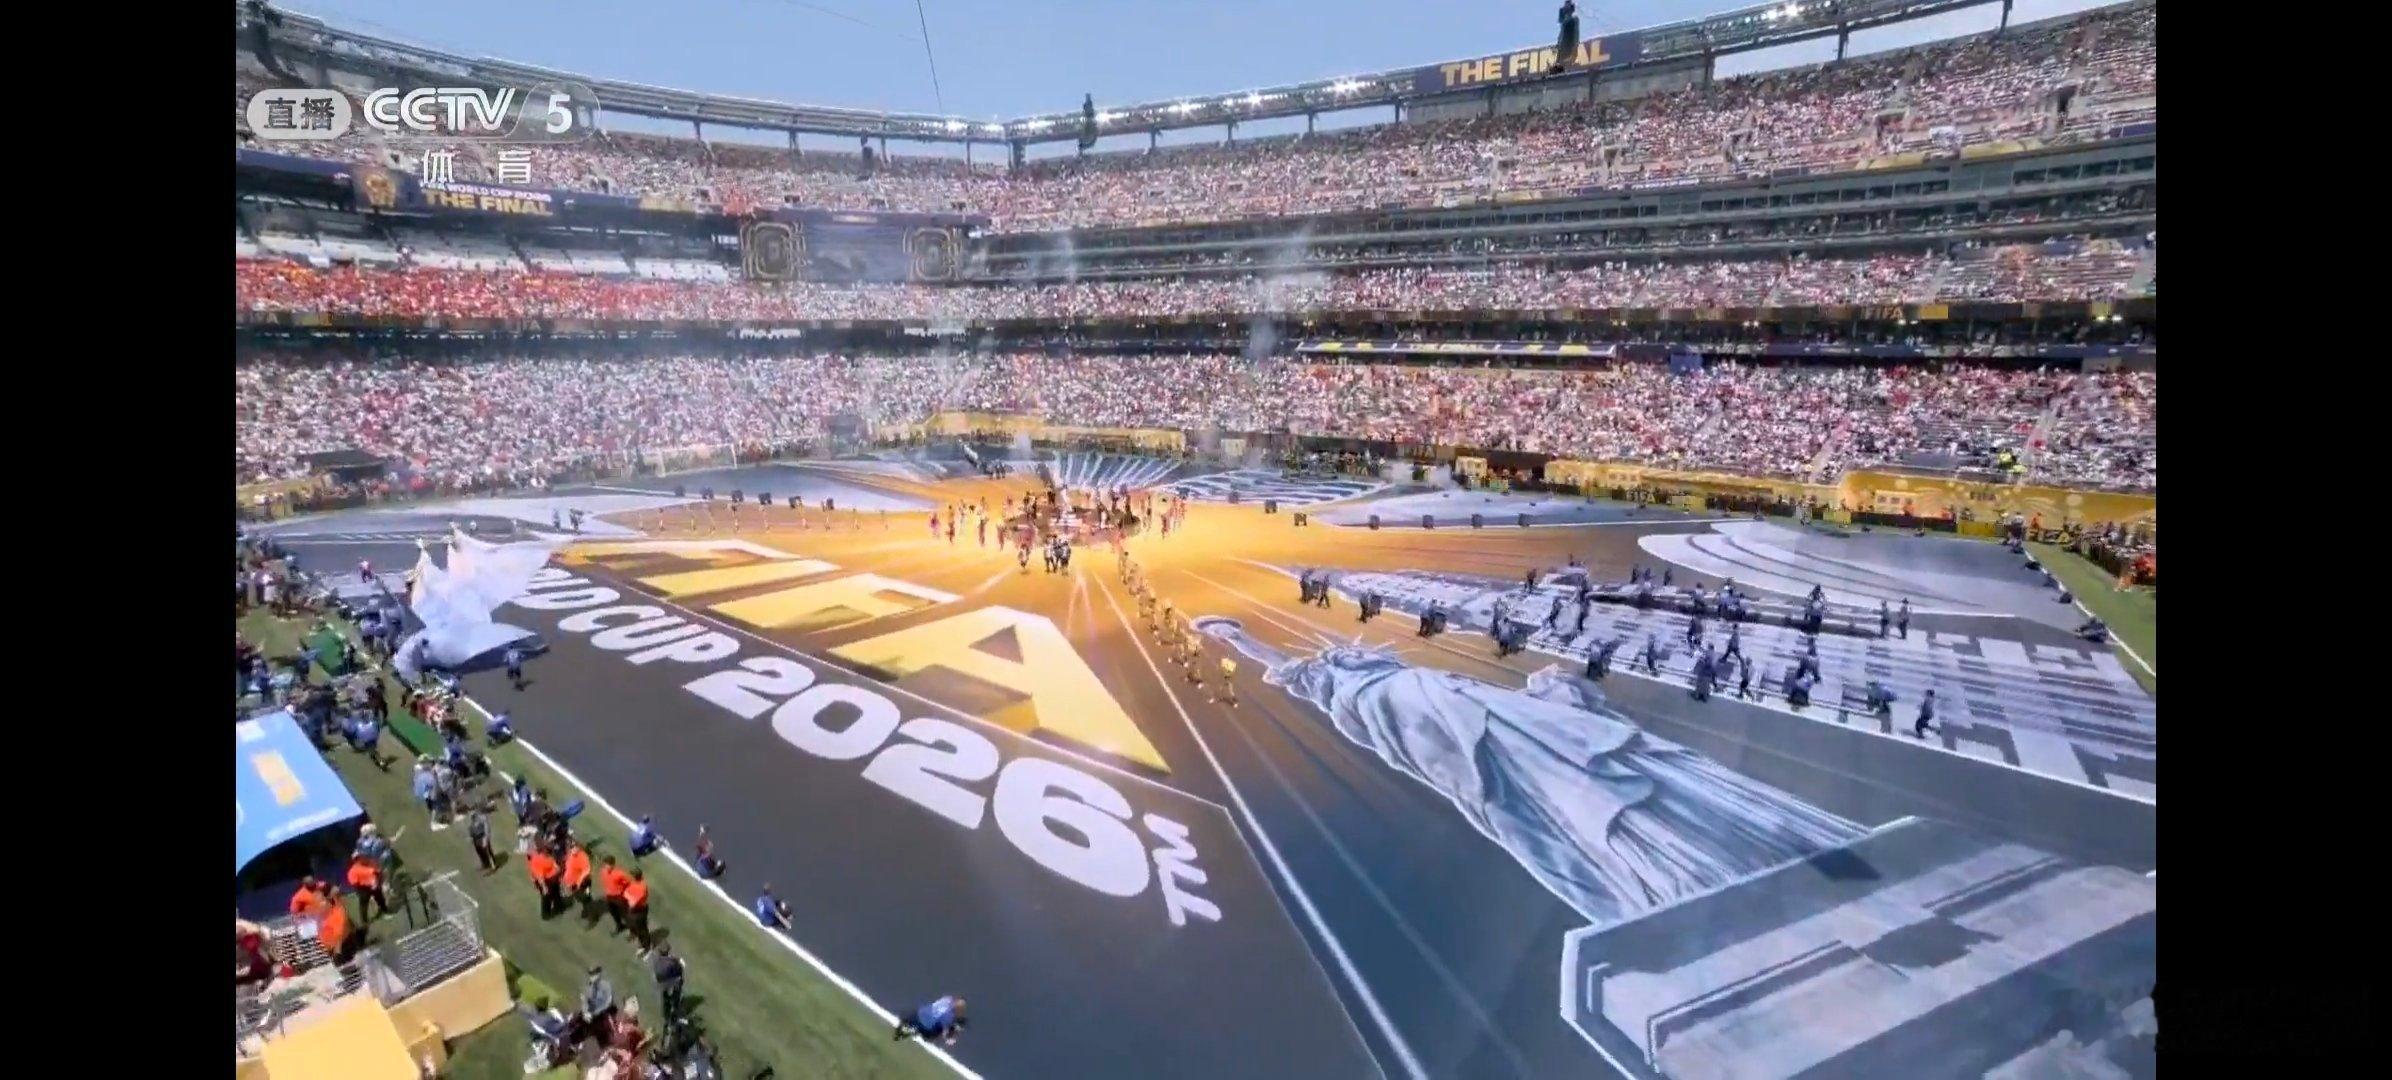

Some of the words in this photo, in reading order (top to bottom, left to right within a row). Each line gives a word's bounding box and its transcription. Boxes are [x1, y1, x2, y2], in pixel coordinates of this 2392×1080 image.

[1440, 56, 1503, 87] THE
[423, 190, 477, 210] THE
[480, 196, 553, 216] FINAL
[446, 183, 489, 196] WORLD
[490, 187, 513, 198] CUP
[558, 539, 1171, 774] FIFA
[558, 605, 740, 665] CUP
[683, 655, 1150, 897] 2026
